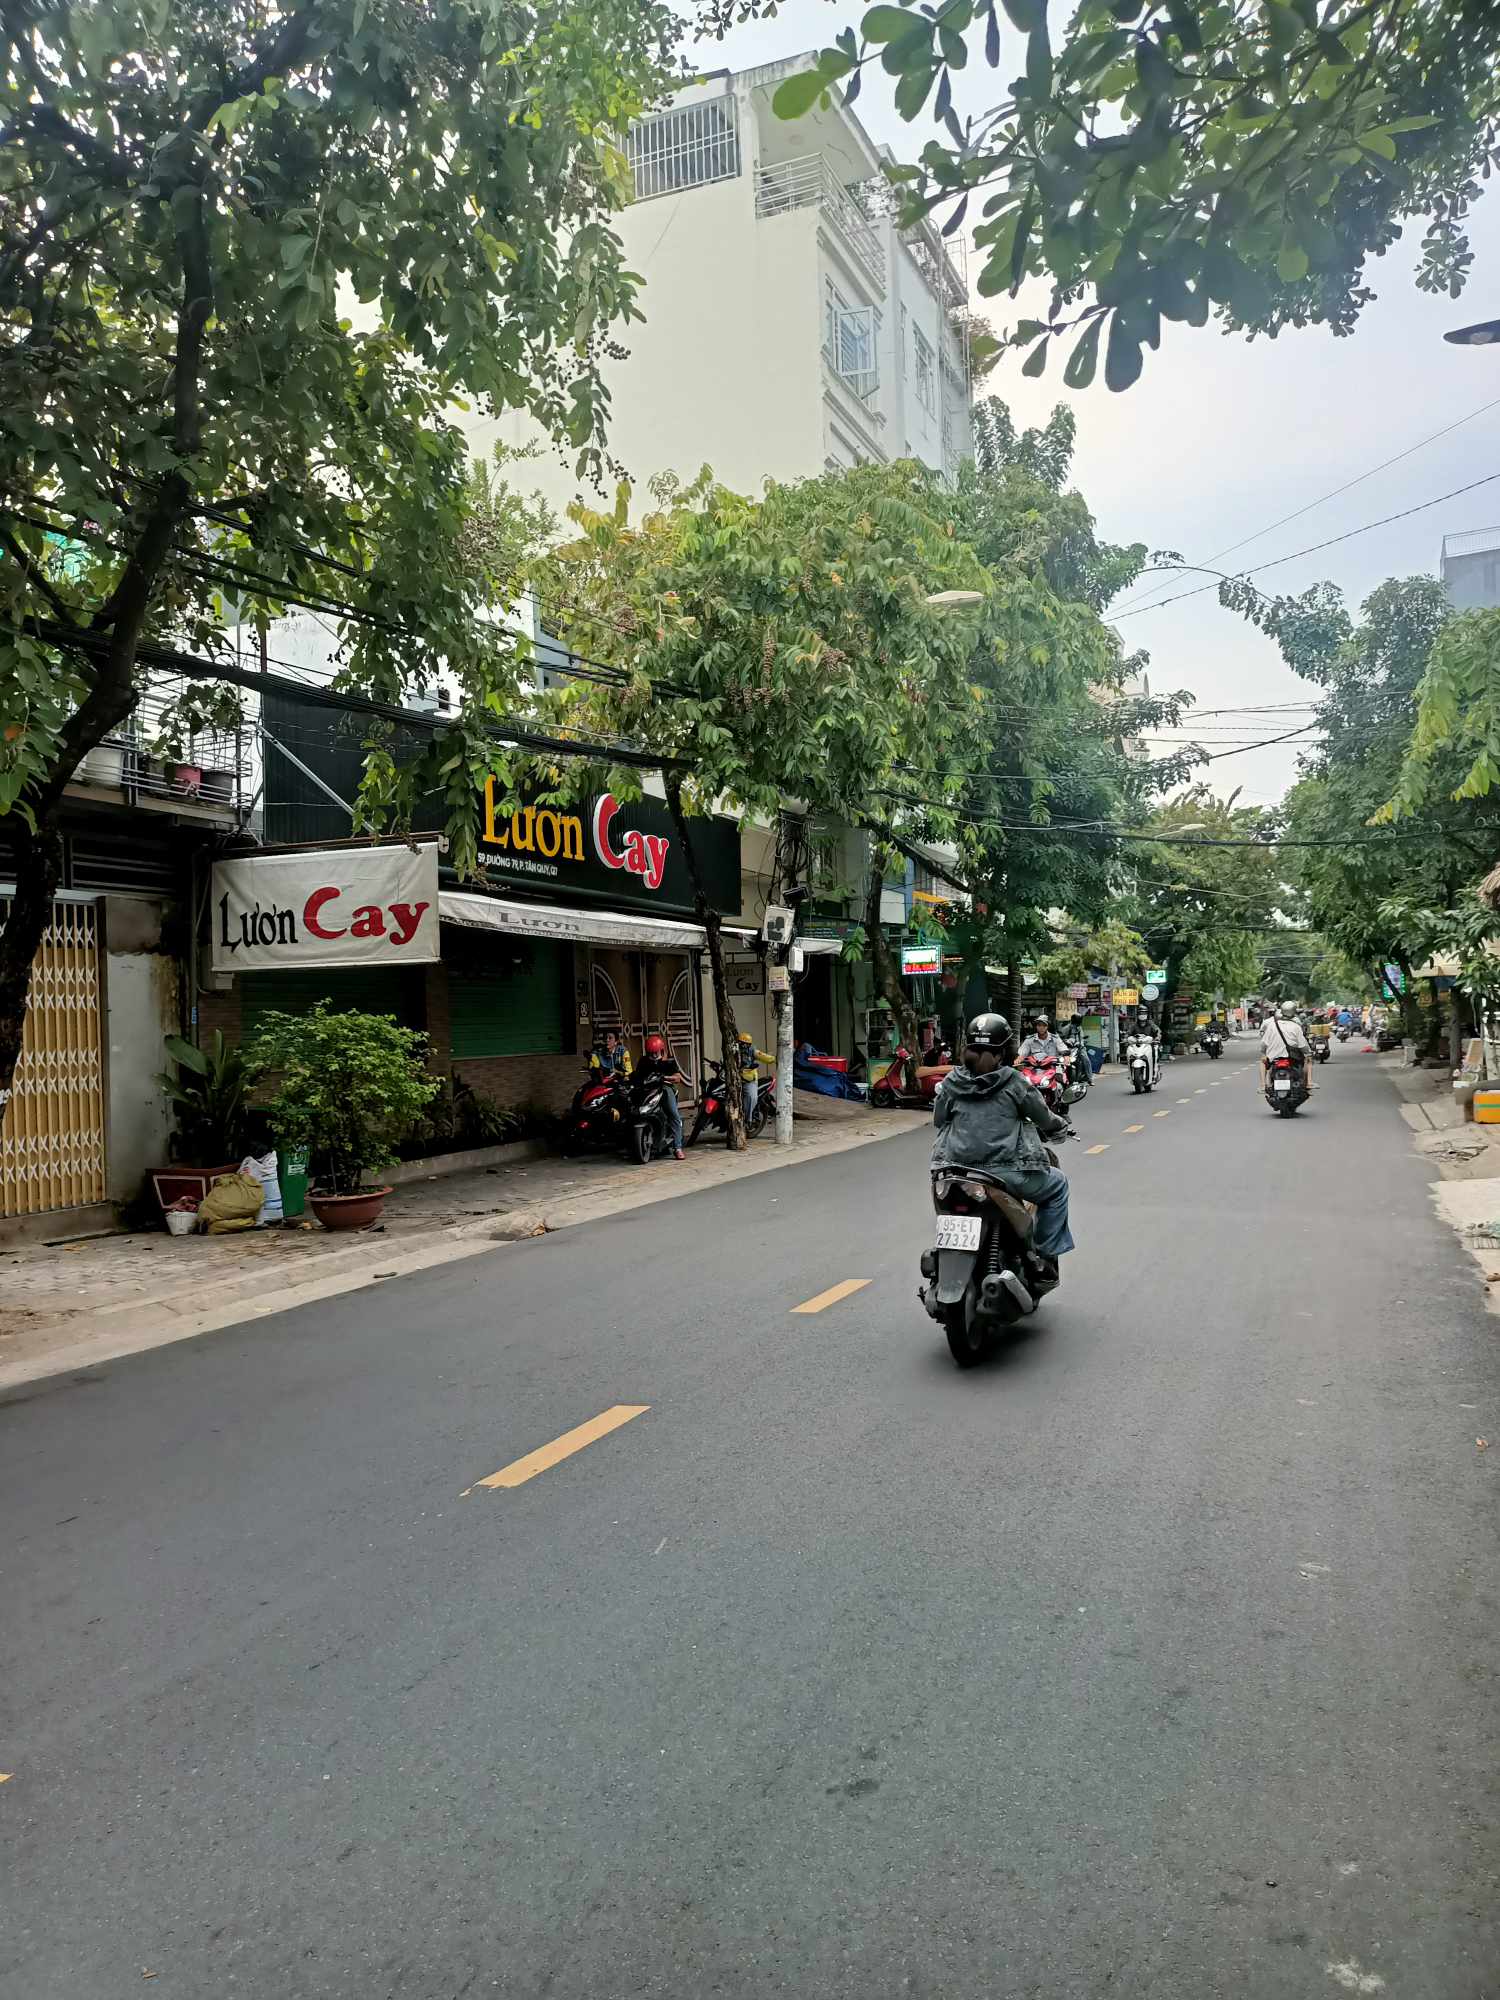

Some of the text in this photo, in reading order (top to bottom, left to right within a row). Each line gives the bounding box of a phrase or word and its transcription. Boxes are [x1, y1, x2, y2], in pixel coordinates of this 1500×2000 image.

[593, 793, 669, 889] Cay
[219, 886, 430, 953] Lươn Cay
[736, 977, 760, 991] Cay
